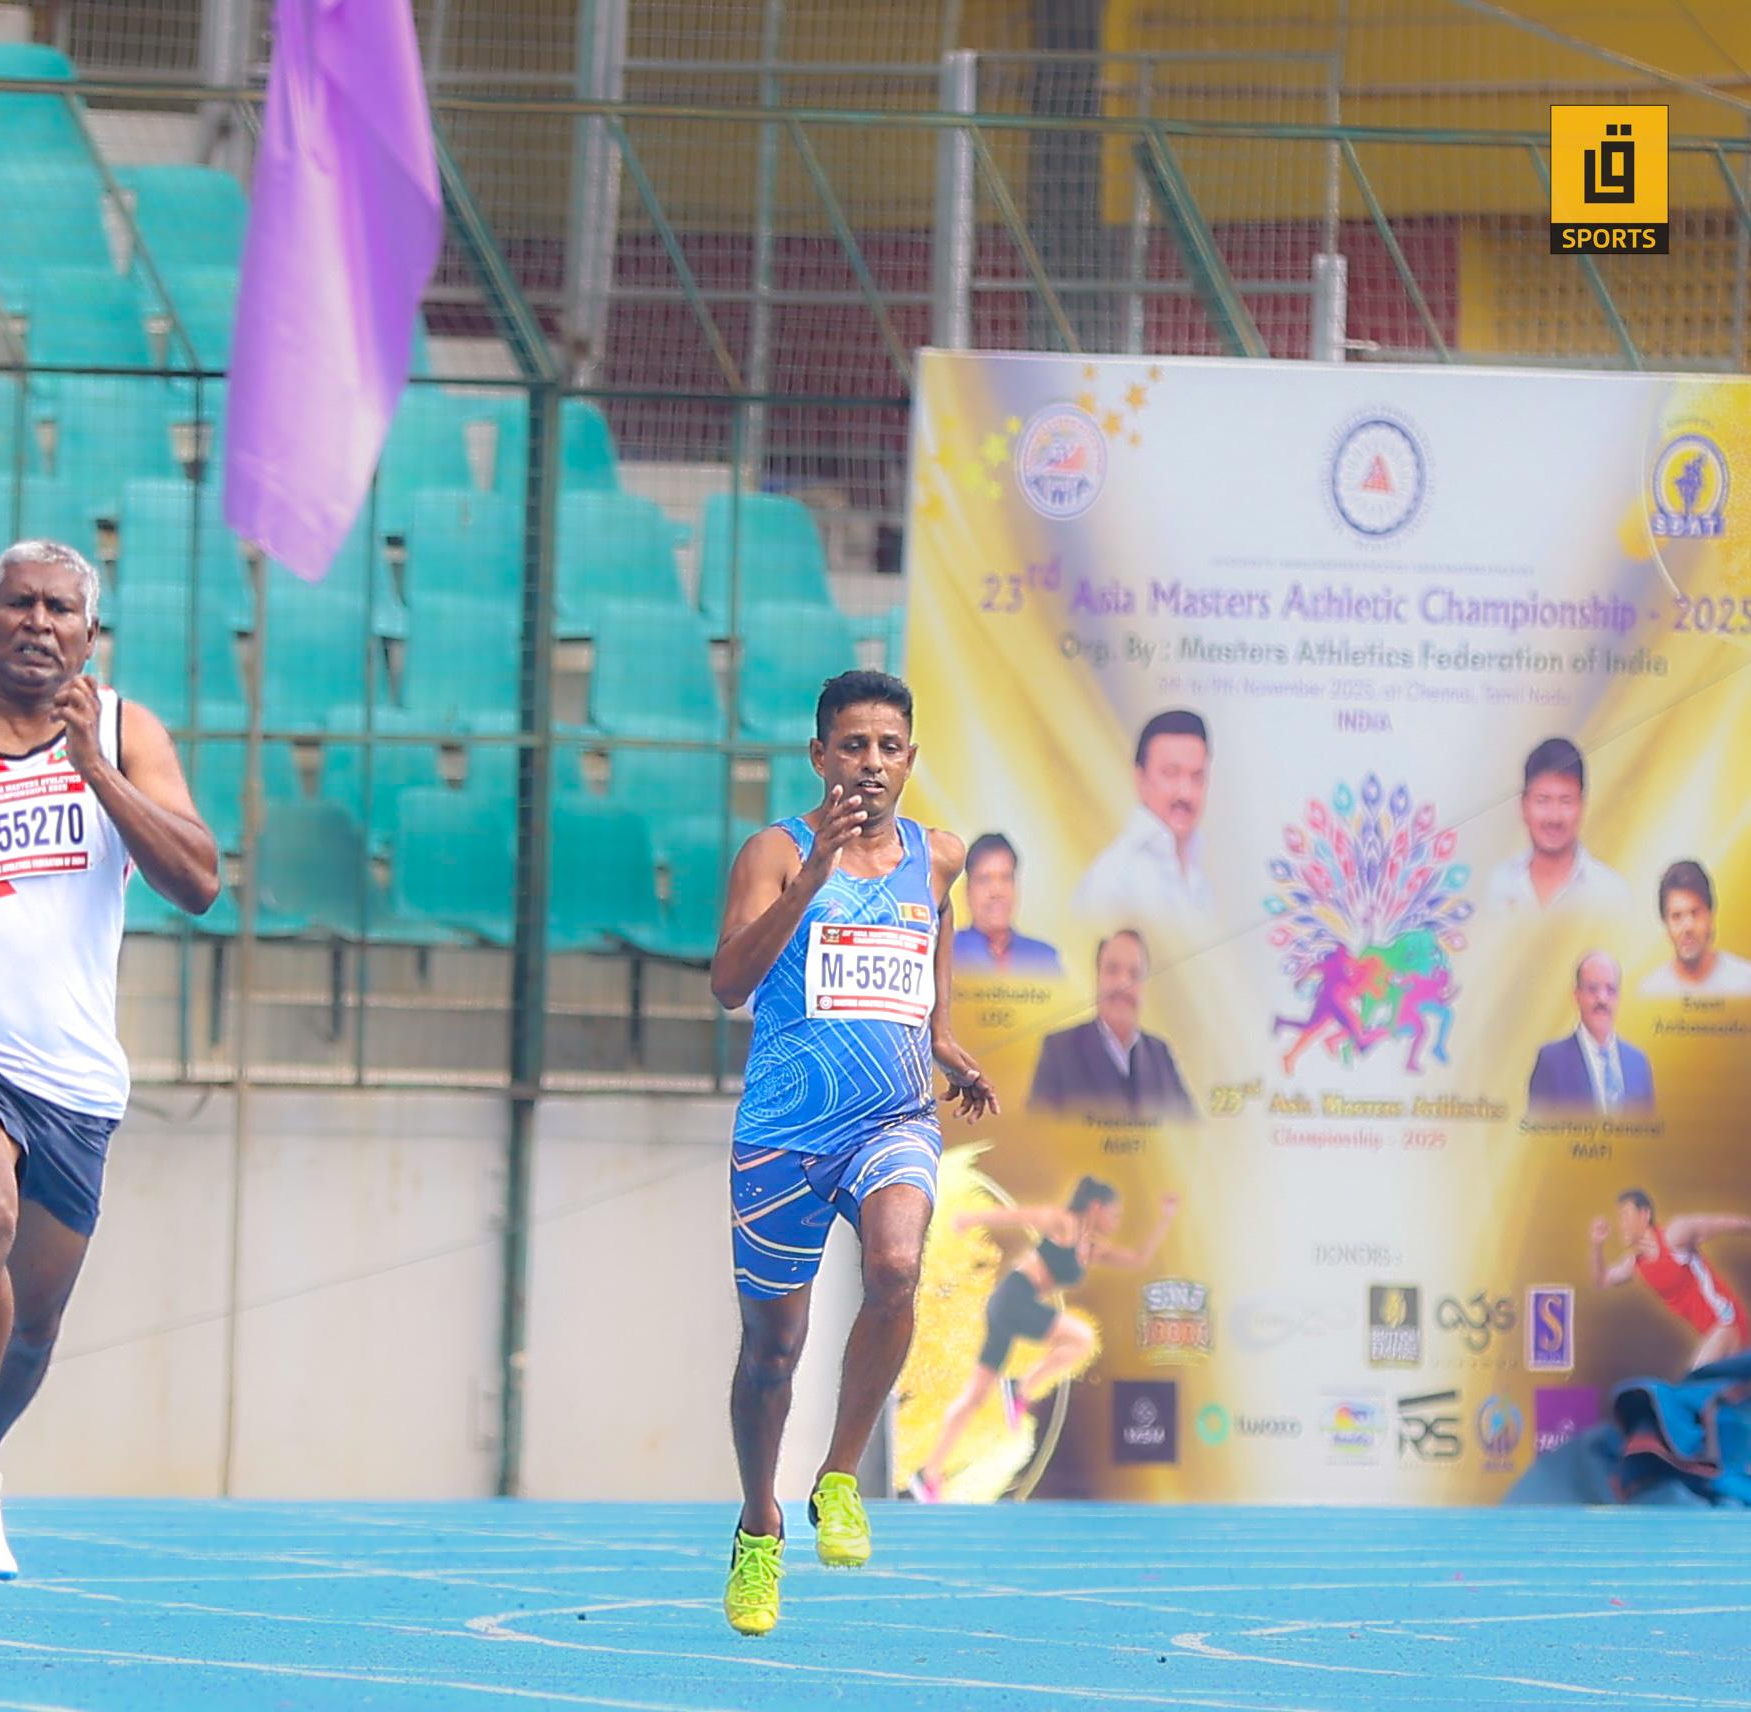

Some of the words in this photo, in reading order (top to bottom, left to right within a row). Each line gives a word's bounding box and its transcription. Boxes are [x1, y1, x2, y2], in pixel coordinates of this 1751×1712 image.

[1070, 577, 1137, 616] Asia
[1151, 579, 1270, 621] Masters
[1419, 587, 1639, 636] Championship
[1298, 640, 1412, 669] Athletics
[1422, 641, 1564, 673] Federation
[1572, 646, 1594, 674] of
[1605, 649, 1669, 676] India
[821, 952, 924, 996] M-55287
